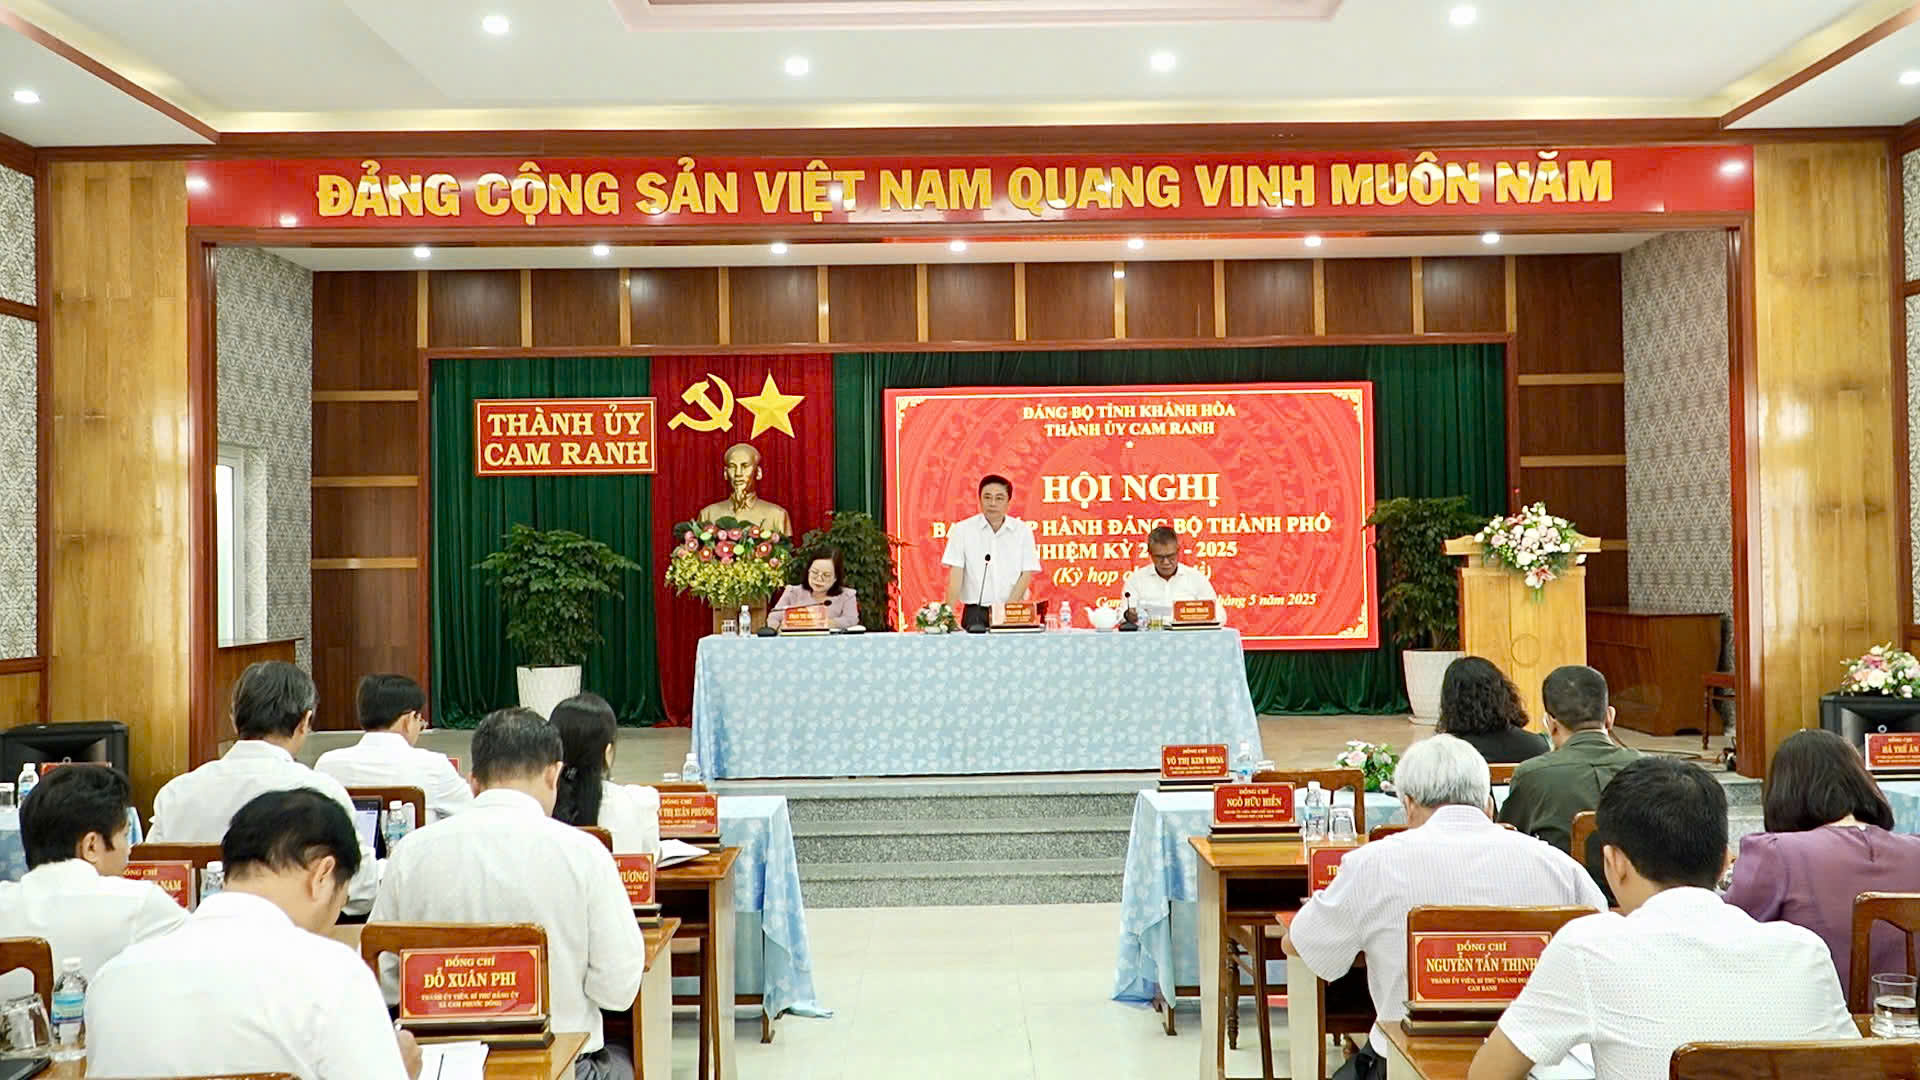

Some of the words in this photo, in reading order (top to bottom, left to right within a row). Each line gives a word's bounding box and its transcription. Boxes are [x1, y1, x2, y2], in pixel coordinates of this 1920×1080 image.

[316, 160, 461, 217] ĐẢNG
[475, 161, 620, 225] CỘNG
[636, 157, 739, 216] SẢN
[753, 160, 865, 222] VIỆT
[880, 168, 992, 211] NAM
[1008, 165, 1180, 217] QUANG
[1194, 165, 1315, 208] VINH
[1330, 151, 1480, 206] MUÔN
[1495, 150, 1613, 203] NĂM
[487, 406, 594, 437] THÀNH
[603, 404, 645, 435] ỦY
[1023, 404, 1068, 420] ĐẢNG
[1072, 404, 1094, 421] BỘ
[1096, 402, 1136, 418] TỈNH
[1139, 402, 1197, 418] KHÁNH
[1200, 401, 1236, 417] HÒA
[1044, 421, 1101, 437] THÀNH
[1104, 420, 1127, 436] ỦY
[1129, 422, 1166, 436] CAM
[1168, 421, 1215, 435] RANH
[484, 442, 551, 466] CAM
[561, 441, 648, 465] RANH
[1041, 471, 1113, 509] HỘI
[1121, 473, 1220, 508] NGHỊ
[1042, 516, 1103, 537] HÀNH
[1173, 516, 1203, 537] BỘ
[1206, 513, 1281, 534] THÀNH
[1287, 512, 1331, 533] PHỐ
[1103, 539, 1134, 560] KỲ
[1196, 541, 1238, 558] 2025
[1053, 567, 1083, 586] (Kỳ
[1087, 566, 1118, 586] họp
[1216, 594, 1246, 608] háng
[1247, 594, 1256, 606] 5
[1259, 595, 1284, 606] năm
[1287, 593, 1317, 606] 2025
[1487, 941, 1507, 952] CHÍ
[476, 955, 496, 967] CHÍ
[1425, 952, 1473, 973] NGUYỄN
[1475, 951, 1499, 972] TẤN
[1502, 957, 1537, 975] THỊNH
[423, 967, 445, 989] ĐỖ
[447, 969, 489, 989] XUÂN
[490, 971, 516, 987] PHI
